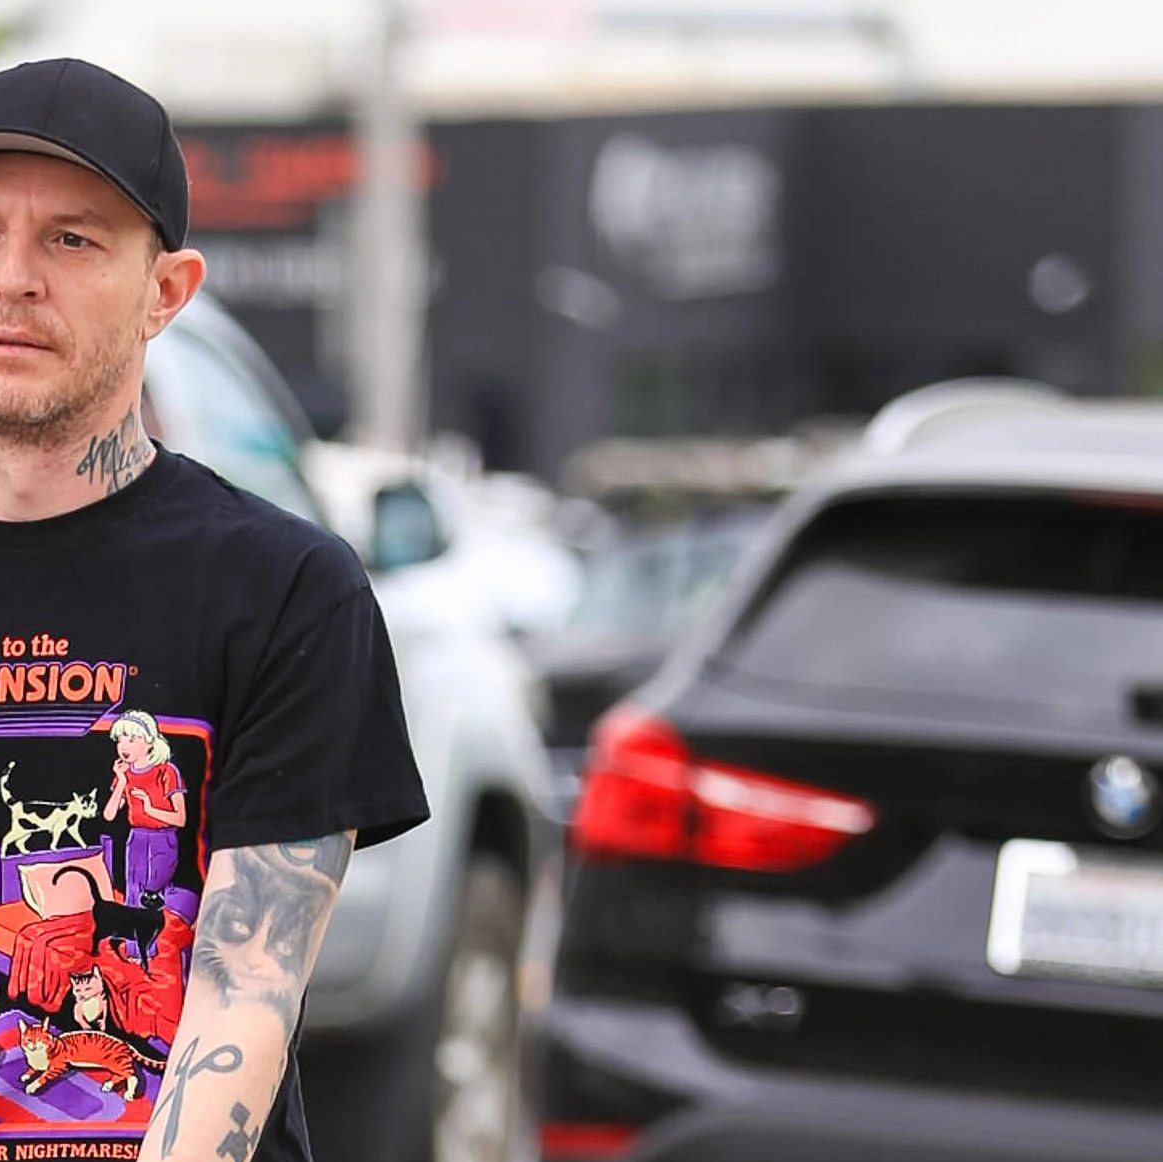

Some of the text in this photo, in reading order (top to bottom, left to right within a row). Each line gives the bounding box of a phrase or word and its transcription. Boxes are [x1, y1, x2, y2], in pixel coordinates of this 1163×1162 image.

[2, 637, 26, 657] to
[31, 634, 69, 656] the
[15, 1143, 138, 1160] NIGHTMARES!
